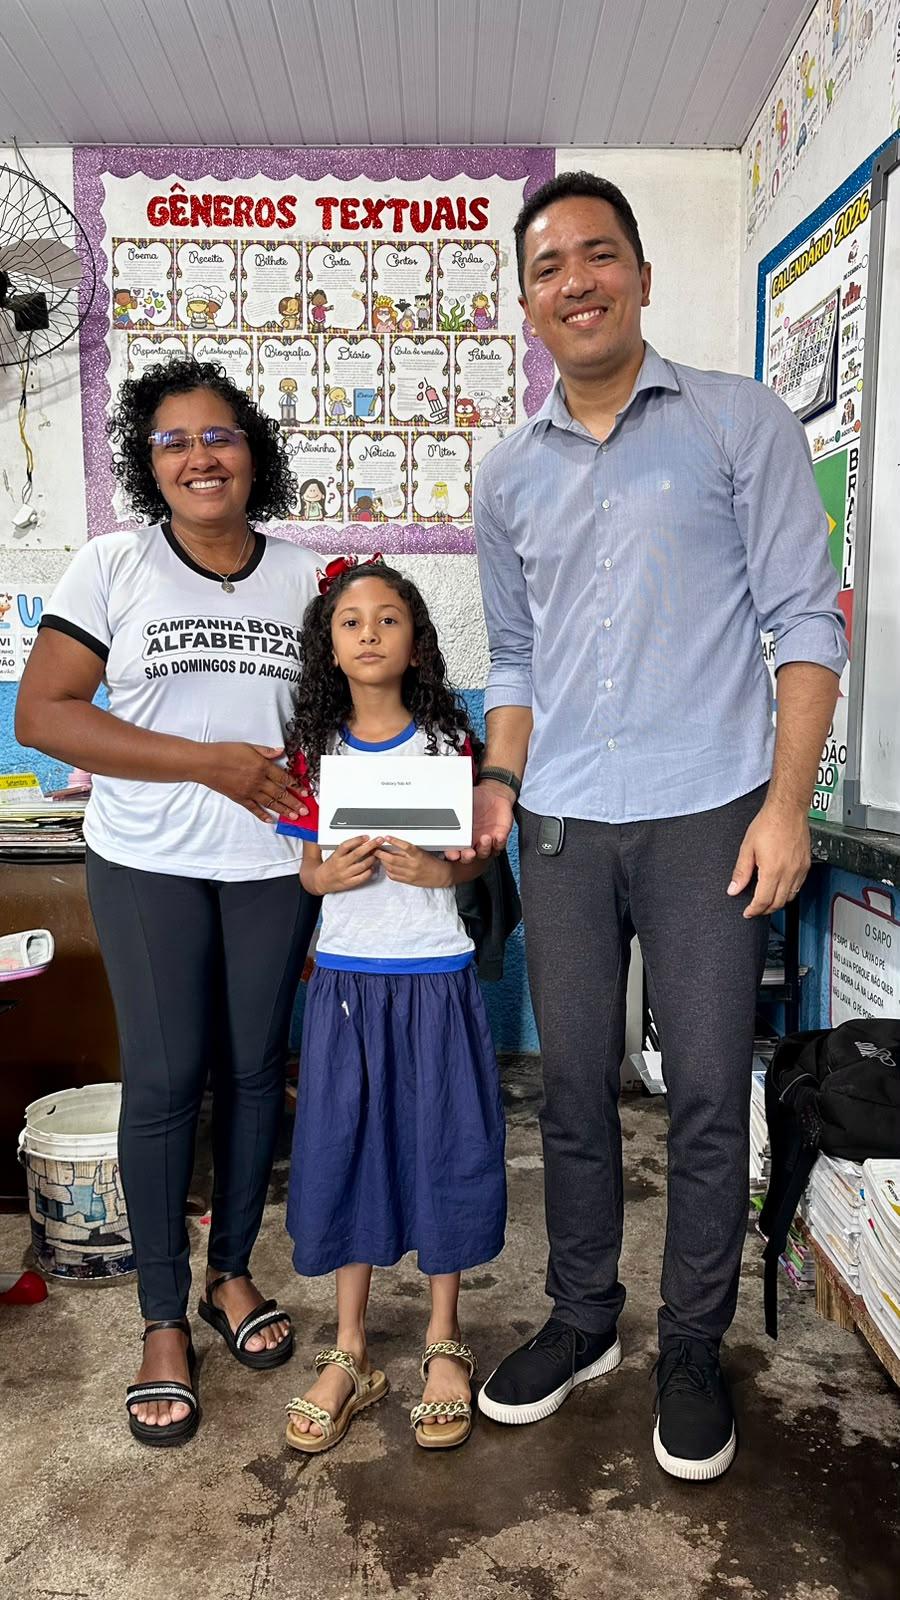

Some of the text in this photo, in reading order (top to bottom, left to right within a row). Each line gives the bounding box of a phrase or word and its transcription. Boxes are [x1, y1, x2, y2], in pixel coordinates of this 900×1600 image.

[147, 182, 490, 233] GÊNEROS TEXTUAIS
[772, 189, 871, 300] CALENDÁRIO 2026
[127, 248, 159, 261] Poema
[188, 250, 225, 265] Receita
[254, 253, 288, 267] Bilhete
[322, 253, 351, 269] Carta
[385, 252, 419, 268] Contos
[451, 250, 484, 269] Lendas
[132, 344, 184, 360] Reportagem
[197, 345, 249, 360] Autobiografia
[264, 345, 311, 361] Biografia
[337, 346, 371, 361] Diário
[394, 345, 411, 356] Bula
[467, 347, 502, 362] Fábula
[293, 440, 337, 455] Adivinha
[359, 444, 397, 461] Notícia
[427, 444, 457, 458] Mitos
[146, 619, 246, 636] CAMPANHA
[144, 662, 169, 680] SÃO
[171, 659, 236, 675] DOMINGOS
[239, 661, 256, 675] DO
[864, 923, 892, 949] O SAPO
[837, 934, 848, 948] SAPO
[849, 940, 860, 955] NÃO
[861, 948, 875, 964] LAVA
[840, 956, 852, 970] LAVA
[852, 961, 870, 981] PORQUE
[870, 973, 881, 988] NÃO
[832, 966, 840, 979] ELE
[840, 971, 854, 988] MORA
[860, 987, 866, 997] NA
[866, 991, 884, 1008] LAGOA
